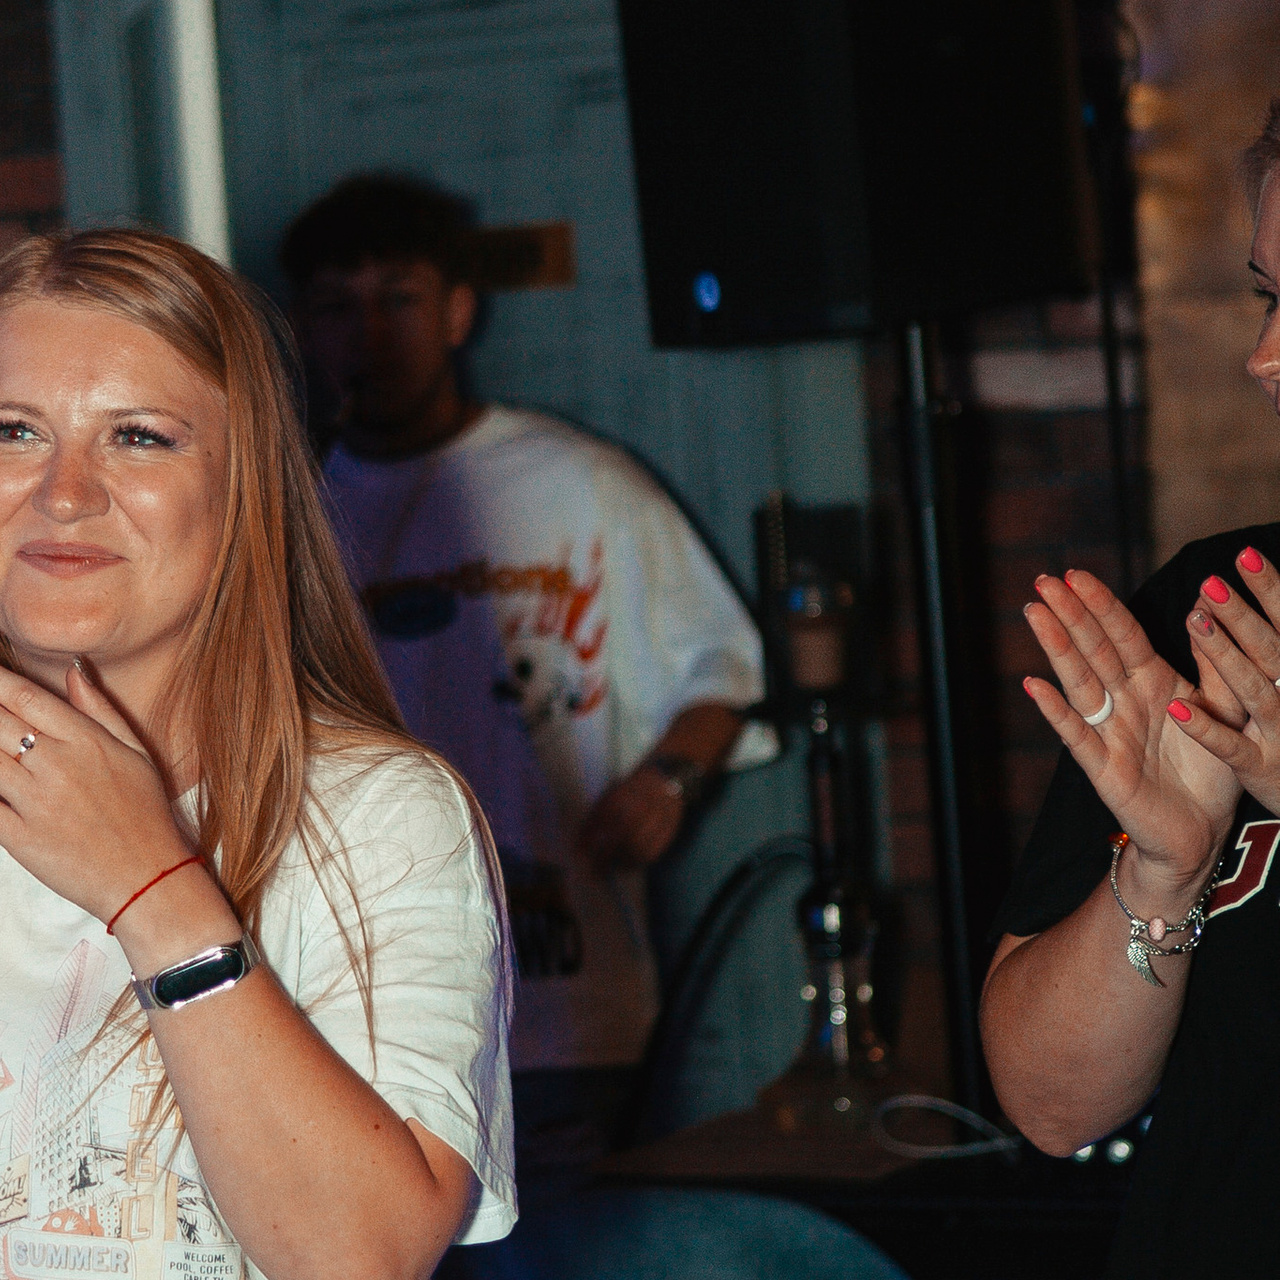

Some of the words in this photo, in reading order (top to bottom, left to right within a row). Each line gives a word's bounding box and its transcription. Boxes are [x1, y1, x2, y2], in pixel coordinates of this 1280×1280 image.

[13, 1239, 131, 1274] SUMMER
[183, 1250, 227, 1264] WELCOME
[199, 1264, 234, 1275] COFFEE
